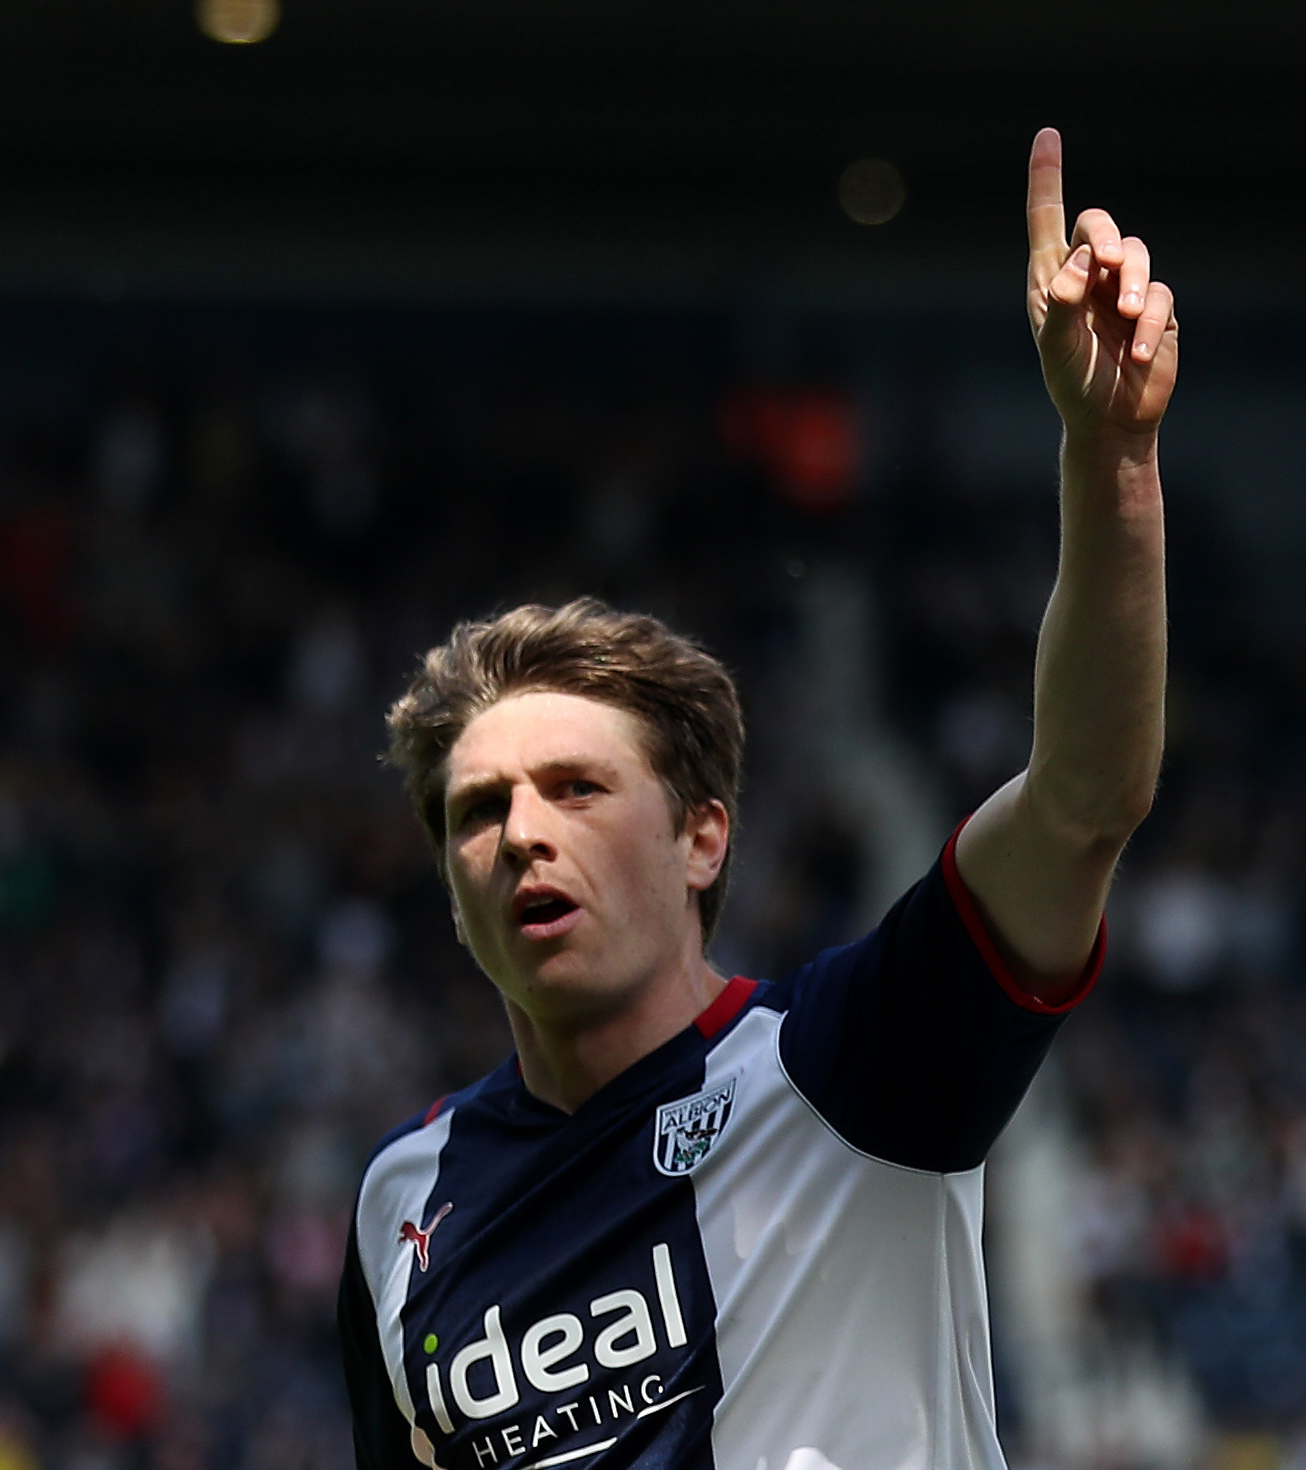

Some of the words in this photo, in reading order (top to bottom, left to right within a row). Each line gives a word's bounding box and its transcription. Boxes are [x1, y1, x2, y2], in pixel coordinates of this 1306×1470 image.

[664, 1088, 731, 1131] ALBION
[423, 1243, 688, 1434] ideal
[472, 1375, 664, 1468] HEATING
